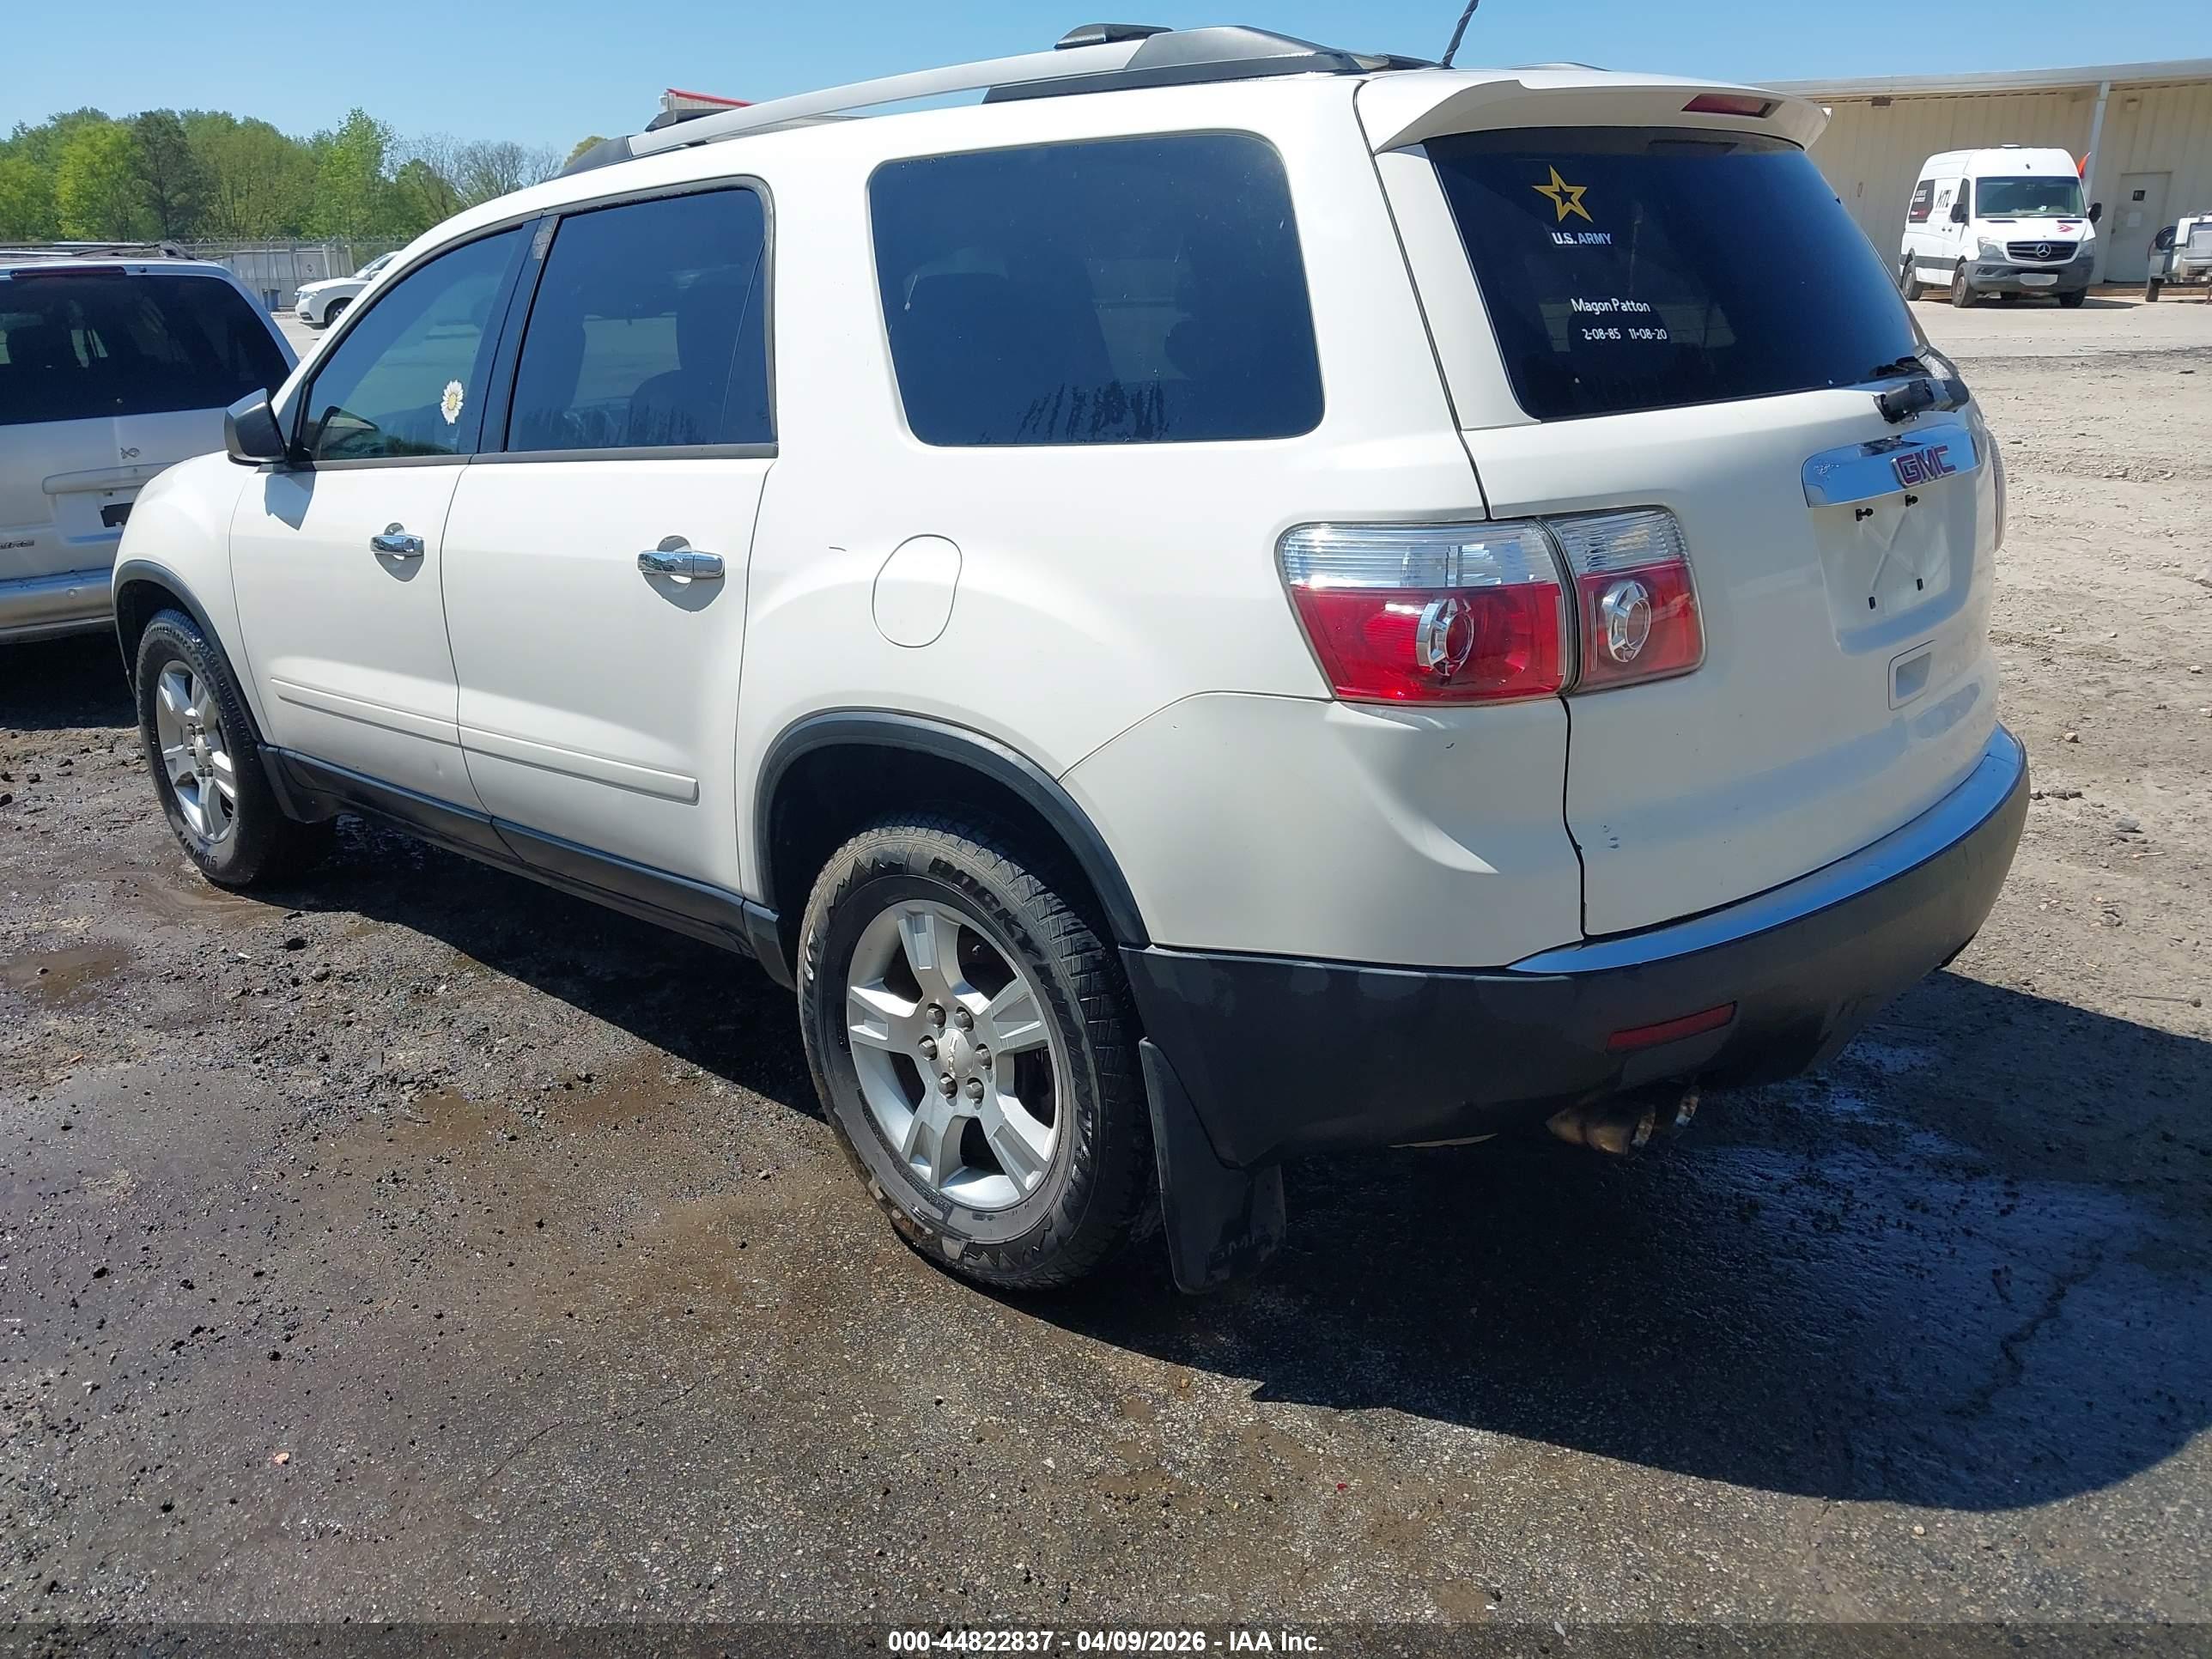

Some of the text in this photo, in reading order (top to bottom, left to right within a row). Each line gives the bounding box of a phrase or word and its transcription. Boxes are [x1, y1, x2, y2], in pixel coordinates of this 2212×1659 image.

[1551, 232, 1613, 246] U.S. ARMY
[1582, 328, 1621, 341] 2-08-85
[1890, 444, 1957, 489] GMC
